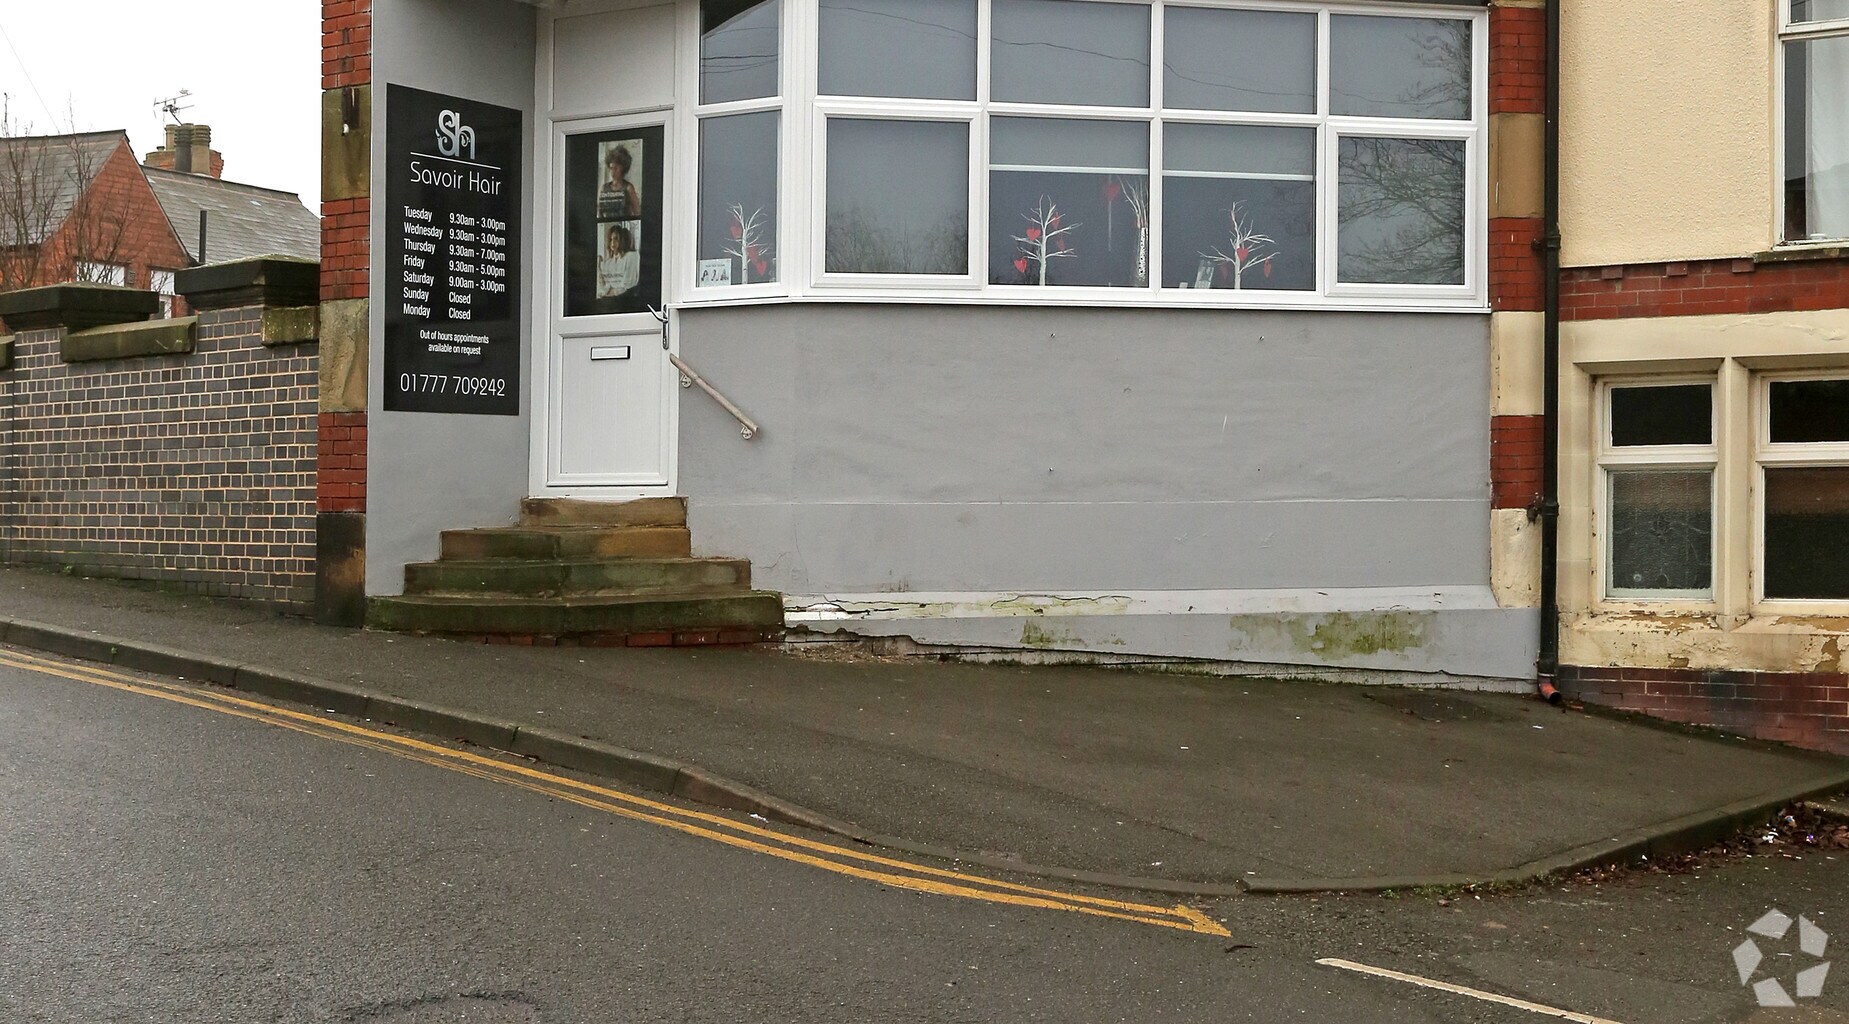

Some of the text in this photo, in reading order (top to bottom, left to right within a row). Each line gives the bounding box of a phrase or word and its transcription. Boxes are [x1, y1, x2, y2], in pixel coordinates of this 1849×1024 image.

[410, 161, 501, 195] Savoir Hair
[404, 205, 433, 223] Tuesday
[449, 212, 475, 227] 9.30am
[481, 217, 506, 231] 3.00pm
[404, 222, 443, 239] Wednesday
[449, 228, 475, 242] 9.30am
[481, 232, 506, 246] 3.00pm
[404, 238, 436, 255] Thursday
[449, 244, 475, 258] 9.30am
[481, 248, 506, 262] 7.00pm
[403, 254, 425, 270] Friday
[449, 260, 475, 274] 9.30am
[481, 264, 506, 277] 5.00pm
[403, 270, 434, 287] Saturday
[448, 276, 475, 289] 9.00am
[480, 279, 506, 293] 3.00pm
[403, 287, 471, 304] Sunday Closed
[403, 303, 471, 320] Monday Closed
[420, 329, 489, 344] Out of hours appointments
[428, 343, 452, 353] available
[461, 346, 481, 356] request
[400, 373, 506, 397] 01777 709242
